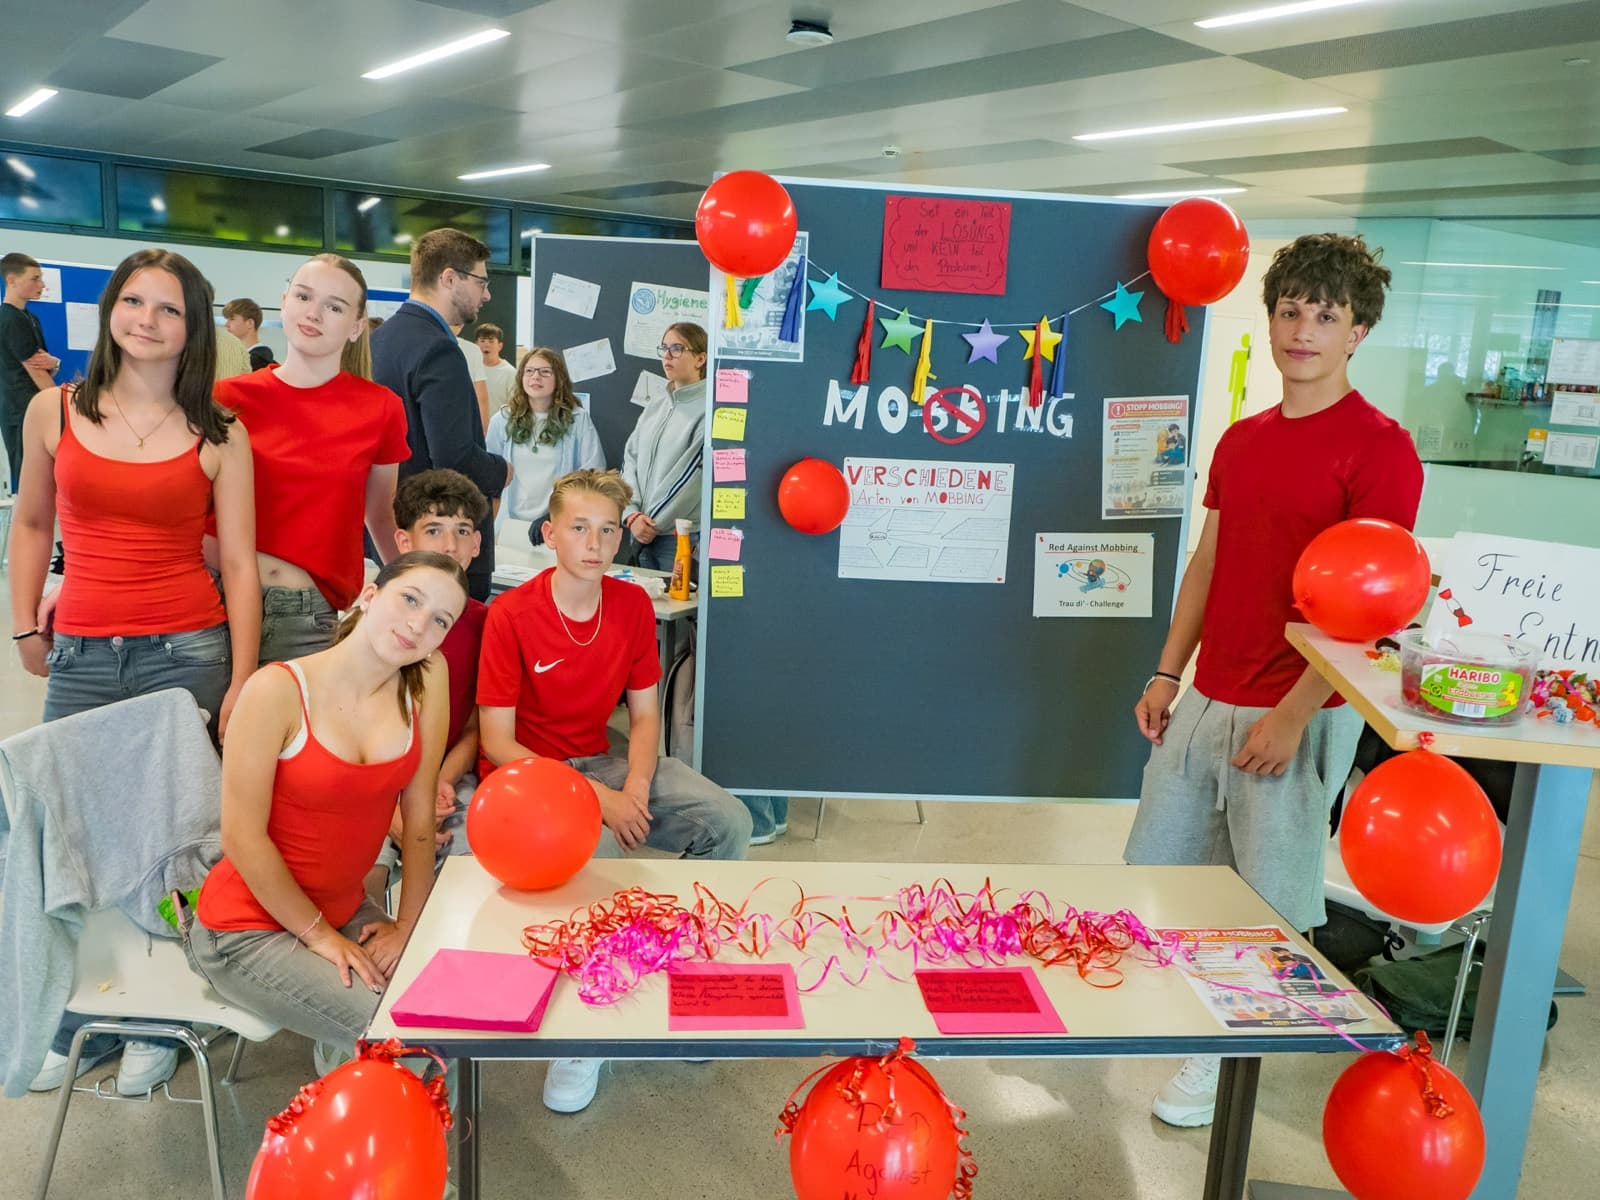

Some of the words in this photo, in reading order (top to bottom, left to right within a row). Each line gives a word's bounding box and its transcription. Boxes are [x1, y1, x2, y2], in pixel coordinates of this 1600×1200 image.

[931, 242, 960, 257] KEIN
[657, 288, 709, 311] Hygiene
[1126, 403, 1148, 411] STOPP
[847, 464, 1009, 492] VERSCHIEDENE
[856, 489, 891, 505] Arten
[900, 494, 920, 505] von
[924, 491, 984, 506] MOBBING
[1048, 543, 1065, 552] Red
[1067, 543, 1098, 553] Against
[1100, 543, 1139, 553] Mobbing
[1472, 552, 1563, 602] Freie
[1058, 600, 1075, 608] Trau
[1089, 600, 1125, 608] Challenge
[1448, 667, 1501, 684] HARIBO
